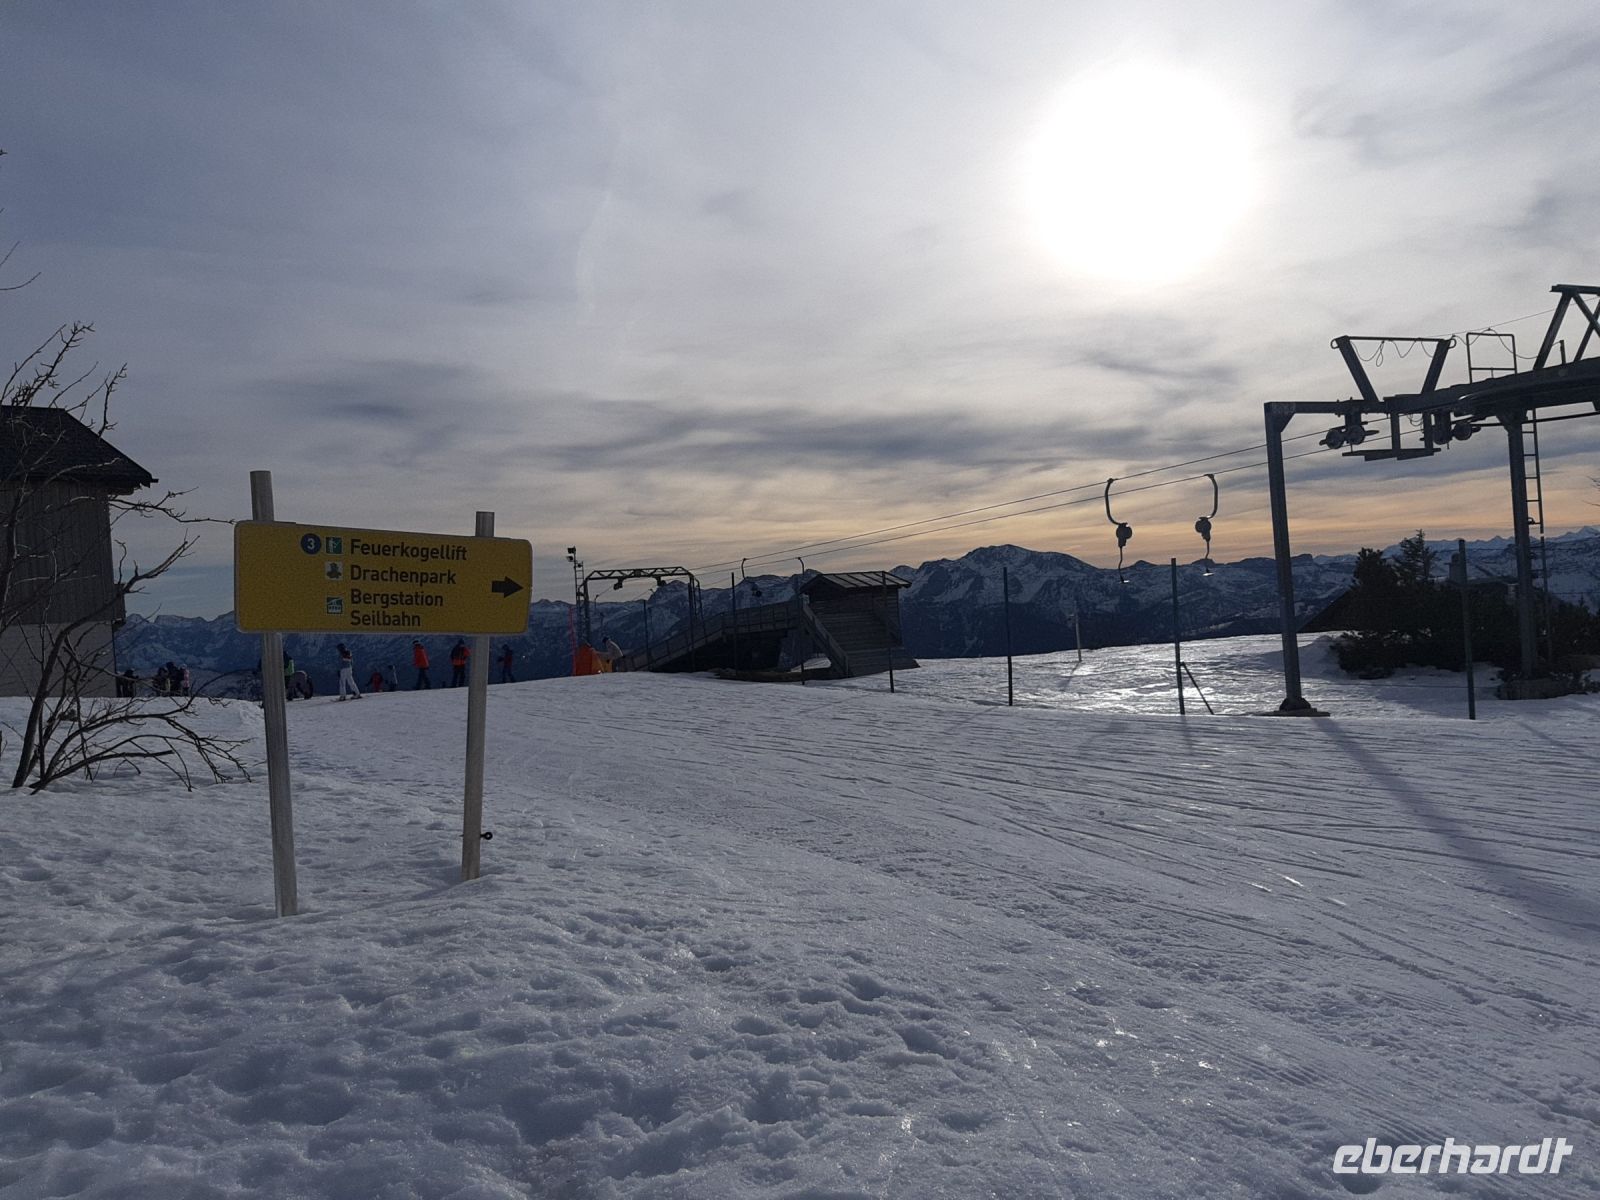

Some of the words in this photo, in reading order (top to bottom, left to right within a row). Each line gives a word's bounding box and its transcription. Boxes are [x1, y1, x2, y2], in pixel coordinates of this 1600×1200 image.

[306, 537, 316, 551] 3
[350, 538, 468, 562] Feuerkogellift
[350, 564, 457, 587] Drachenpark
[350, 589, 444, 608] Bergstation
[350, 610, 421, 627] Seilbahn
